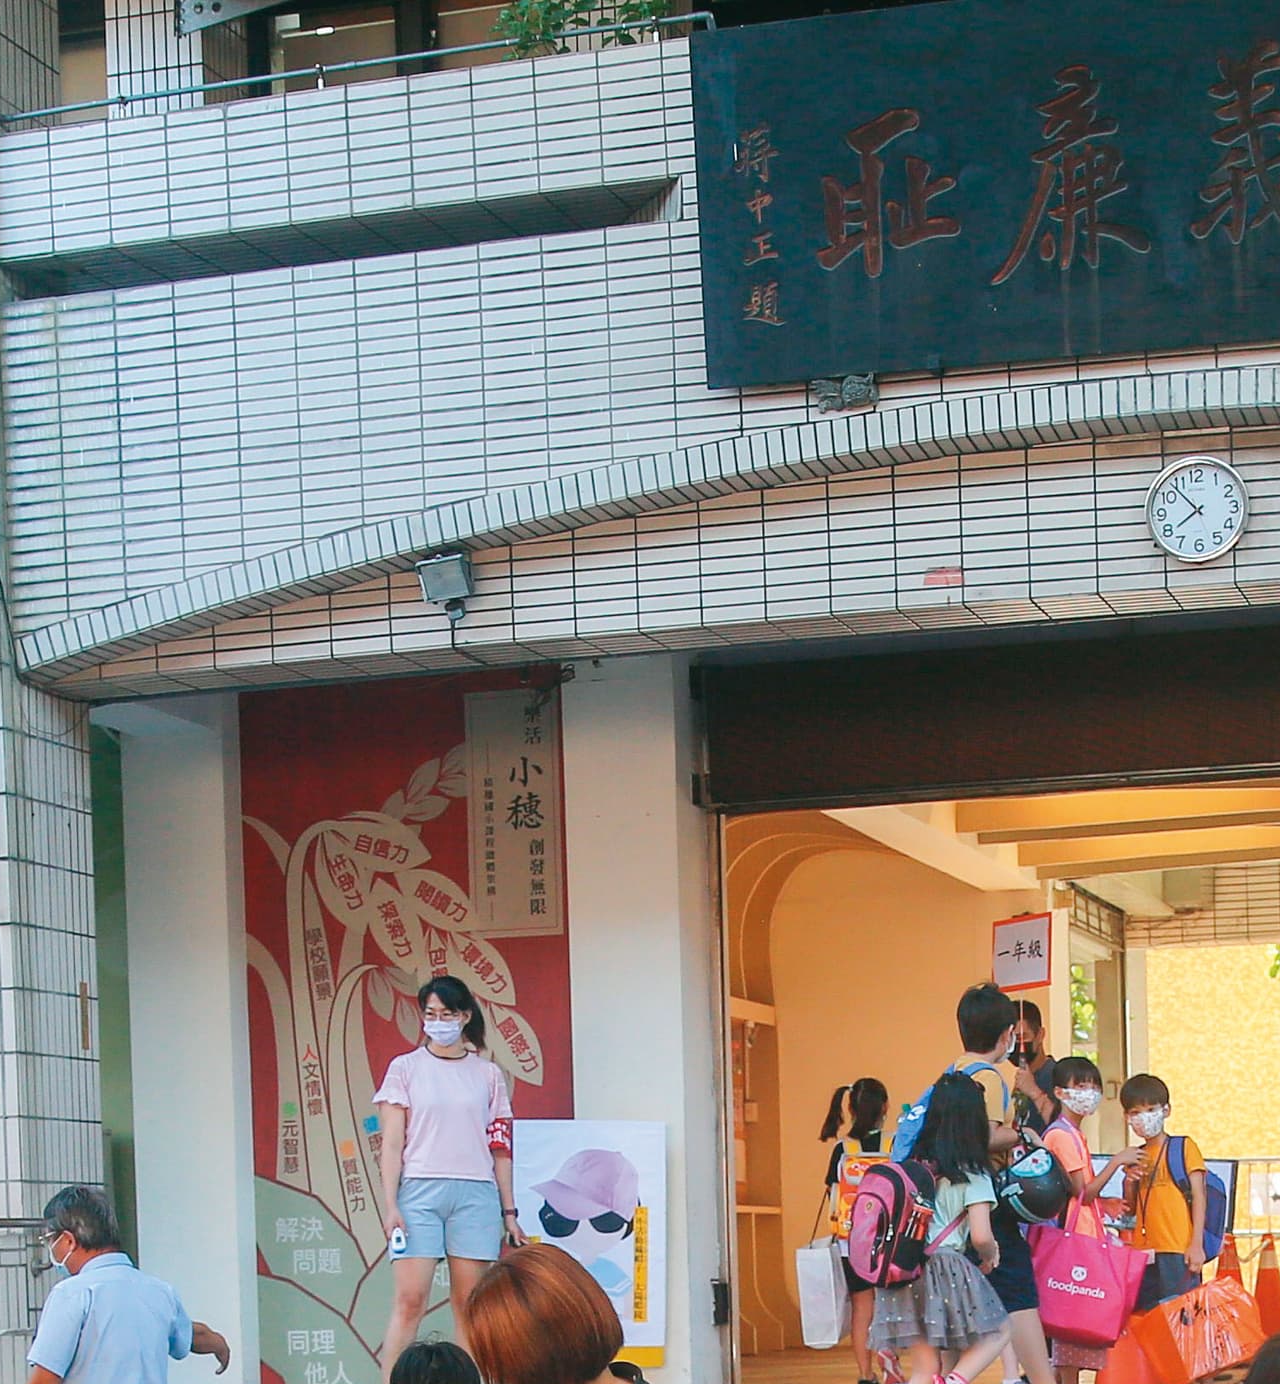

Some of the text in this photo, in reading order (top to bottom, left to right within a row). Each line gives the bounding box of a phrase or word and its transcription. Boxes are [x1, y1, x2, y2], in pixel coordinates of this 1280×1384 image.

[1189, 469, 1203, 483] 12
[1214, 472, 1218, 486] 1
[1161, 490, 1177, 504] 10
[1224, 484, 1234, 498] 2
[1156, 507, 1167, 521] 9
[1229, 500, 1239, 514] 3
[1162, 524, 1173, 538] 8
[1224, 518, 1234, 531] 4
[1176, 535, 1186, 549] 7
[1212, 531, 1223, 545] 5
[1194, 539, 1205, 552] 6
[505, 757, 544, 830] 小穗
[354, 834, 409, 864] 自信力
[329, 854, 363, 910] 生命力
[377, 900, 412, 957] 探索力
[997, 940, 1043, 963] 一年級
[497, 1016, 538, 1072] 國際力
[275, 1217, 323, 1243] 解決
[293, 1248, 342, 1275] 問題
[1047, 1277, 1105, 1299] foodpanda
[287, 1329, 336, 1356] 同理
